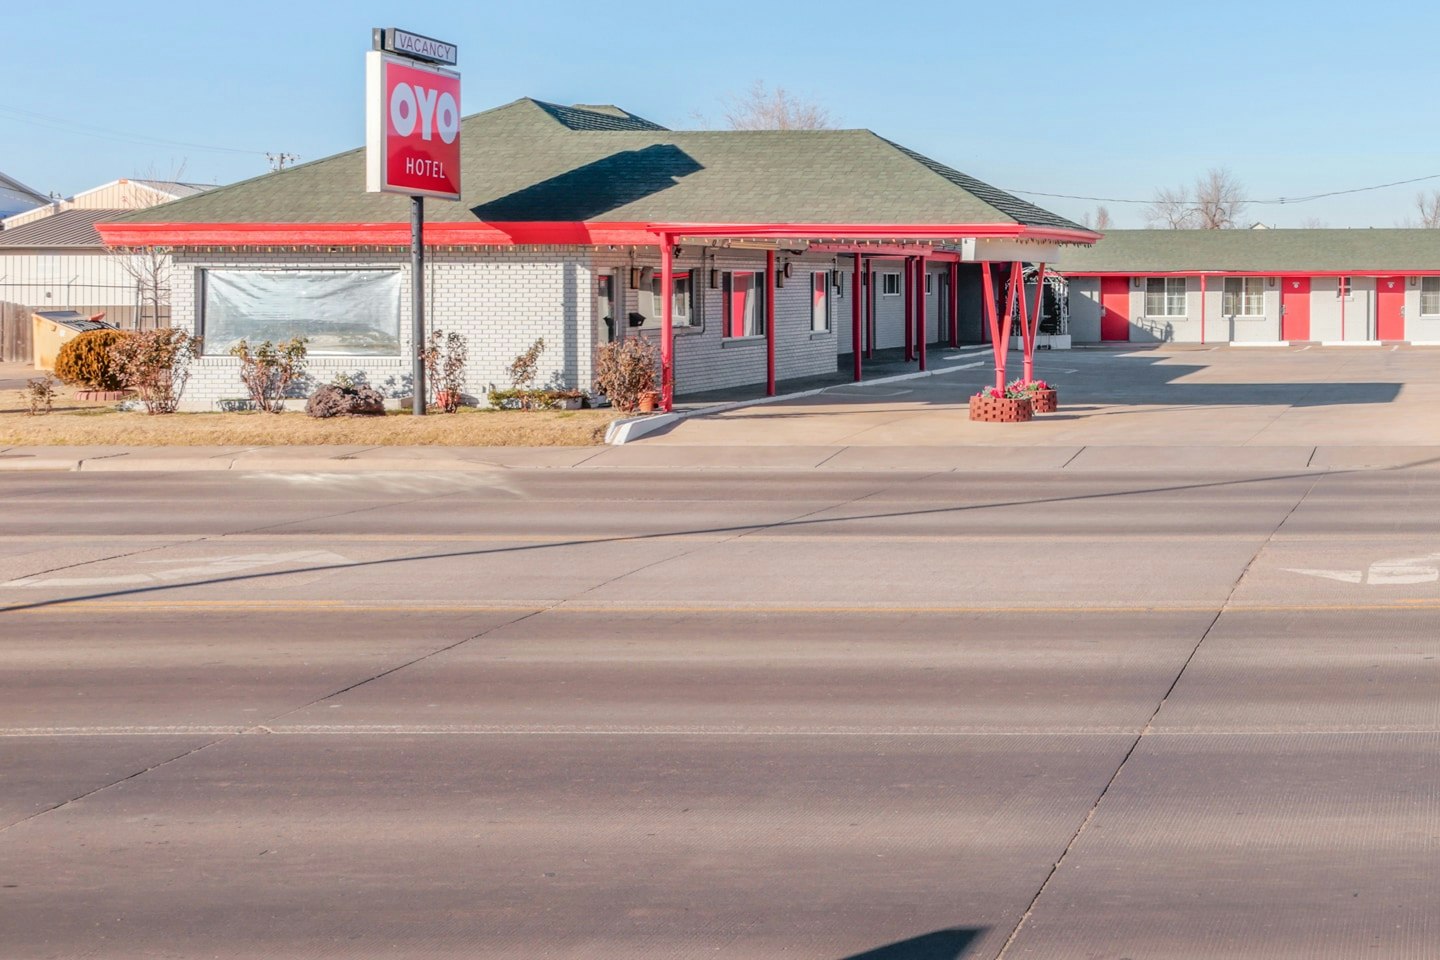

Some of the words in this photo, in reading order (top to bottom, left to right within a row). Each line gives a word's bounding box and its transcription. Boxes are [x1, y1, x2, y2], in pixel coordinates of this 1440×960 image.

[399, 34, 451, 59] VACANCY
[391, 82, 458, 144] OYO
[406, 157, 445, 178] HOTEL
